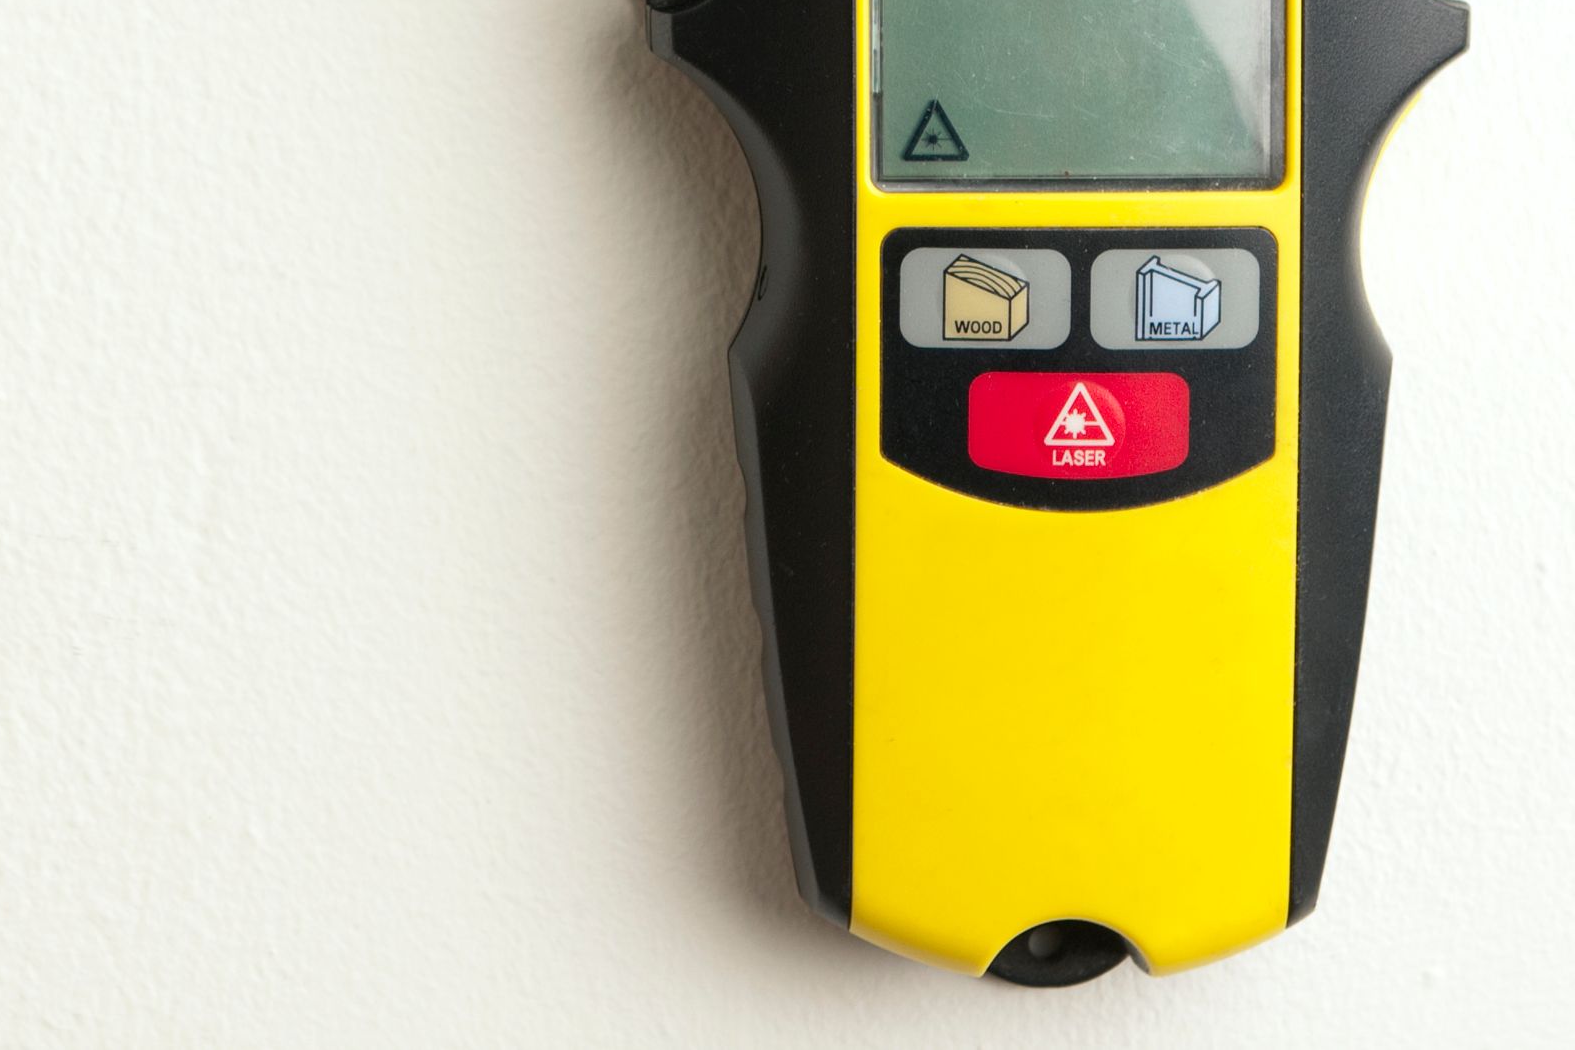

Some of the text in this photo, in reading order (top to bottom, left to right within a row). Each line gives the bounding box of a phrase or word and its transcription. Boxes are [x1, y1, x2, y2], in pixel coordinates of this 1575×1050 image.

[954, 320, 1003, 335] WOOD
[1149, 321, 1199, 336] METAL
[1052, 450, 1106, 467] LASER
